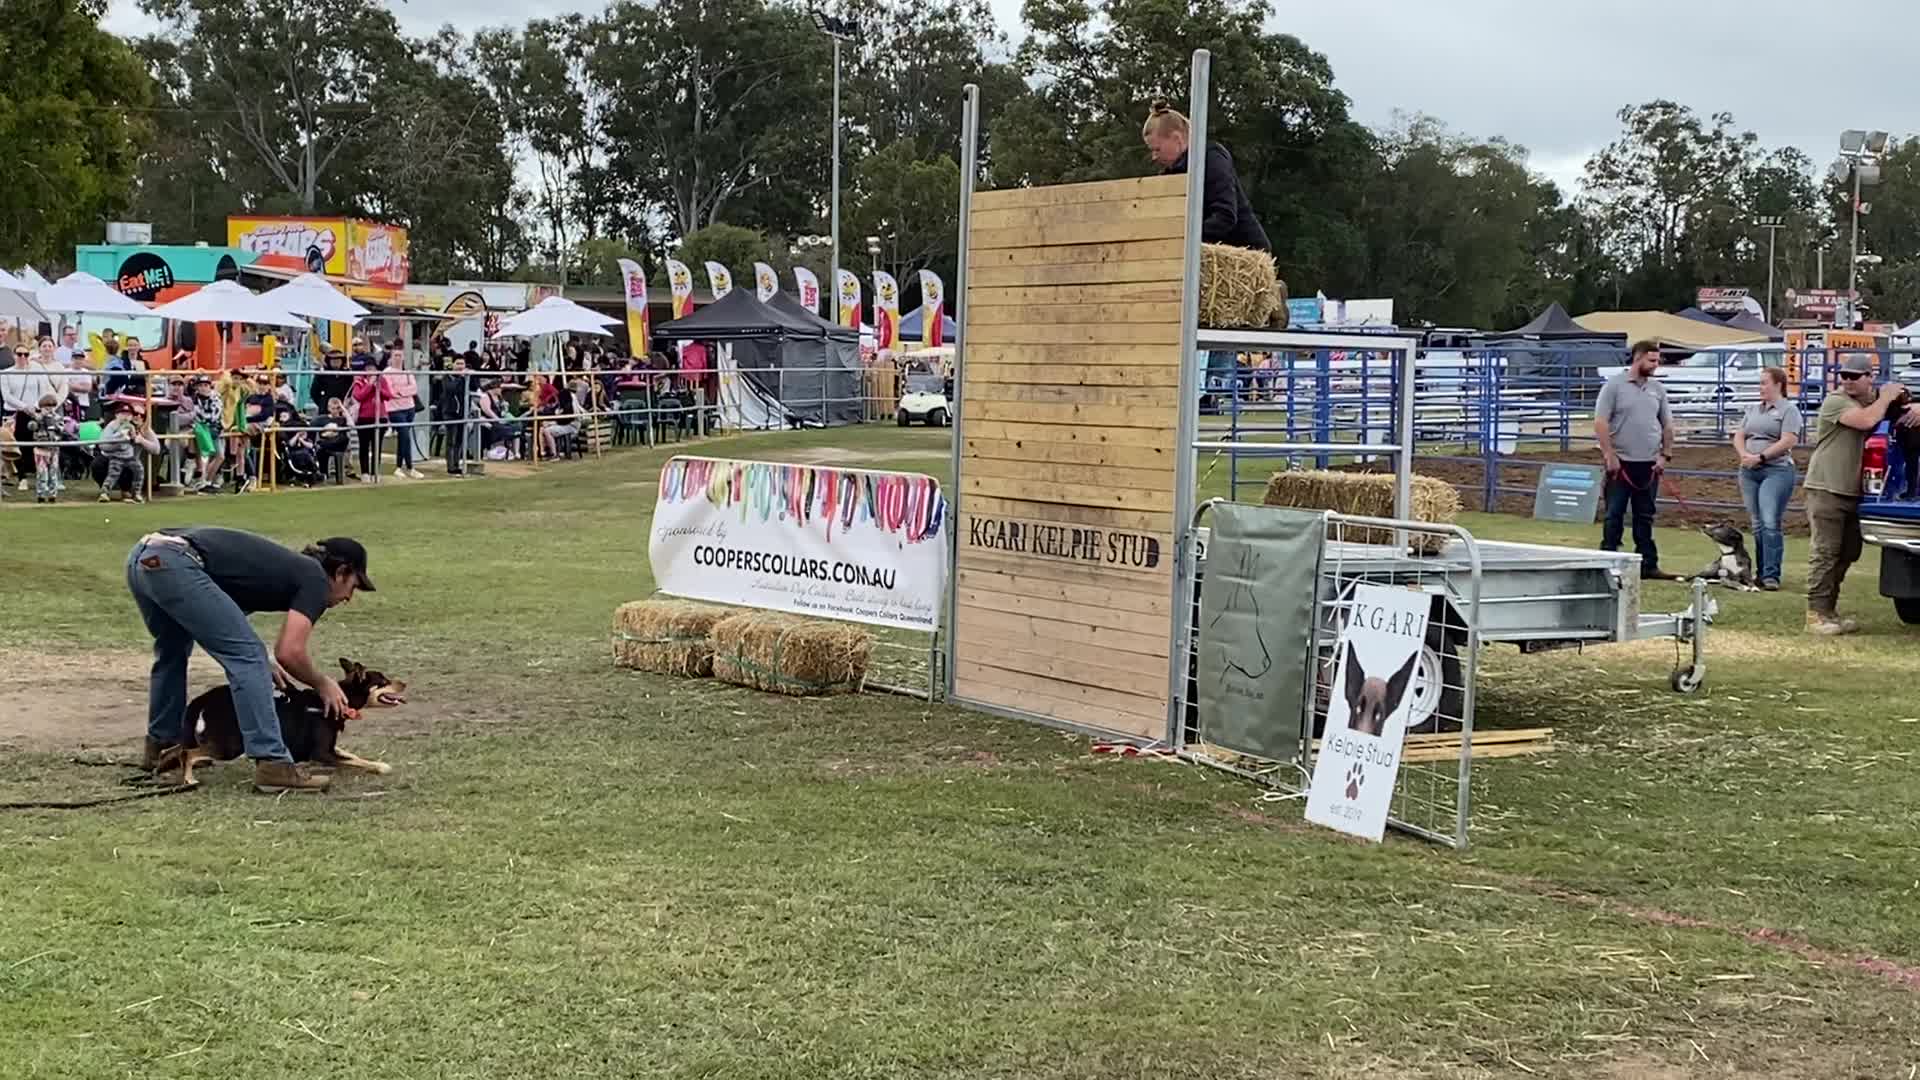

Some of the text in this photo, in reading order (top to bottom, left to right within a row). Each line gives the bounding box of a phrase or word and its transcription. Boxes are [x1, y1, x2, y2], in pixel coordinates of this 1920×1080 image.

[1793, 296, 1820, 307] JUNK
[969, 515, 1160, 568] KGARI KELPIE STUD
[694, 545, 896, 590] COOPERSCOLLARS.COM.AU
[794, 598, 810, 609] Follow
[855, 608, 878, 618] Coopers
[1352, 603, 1425, 638] KGARI
[1327, 733, 1393, 768] Kelpie Stud
